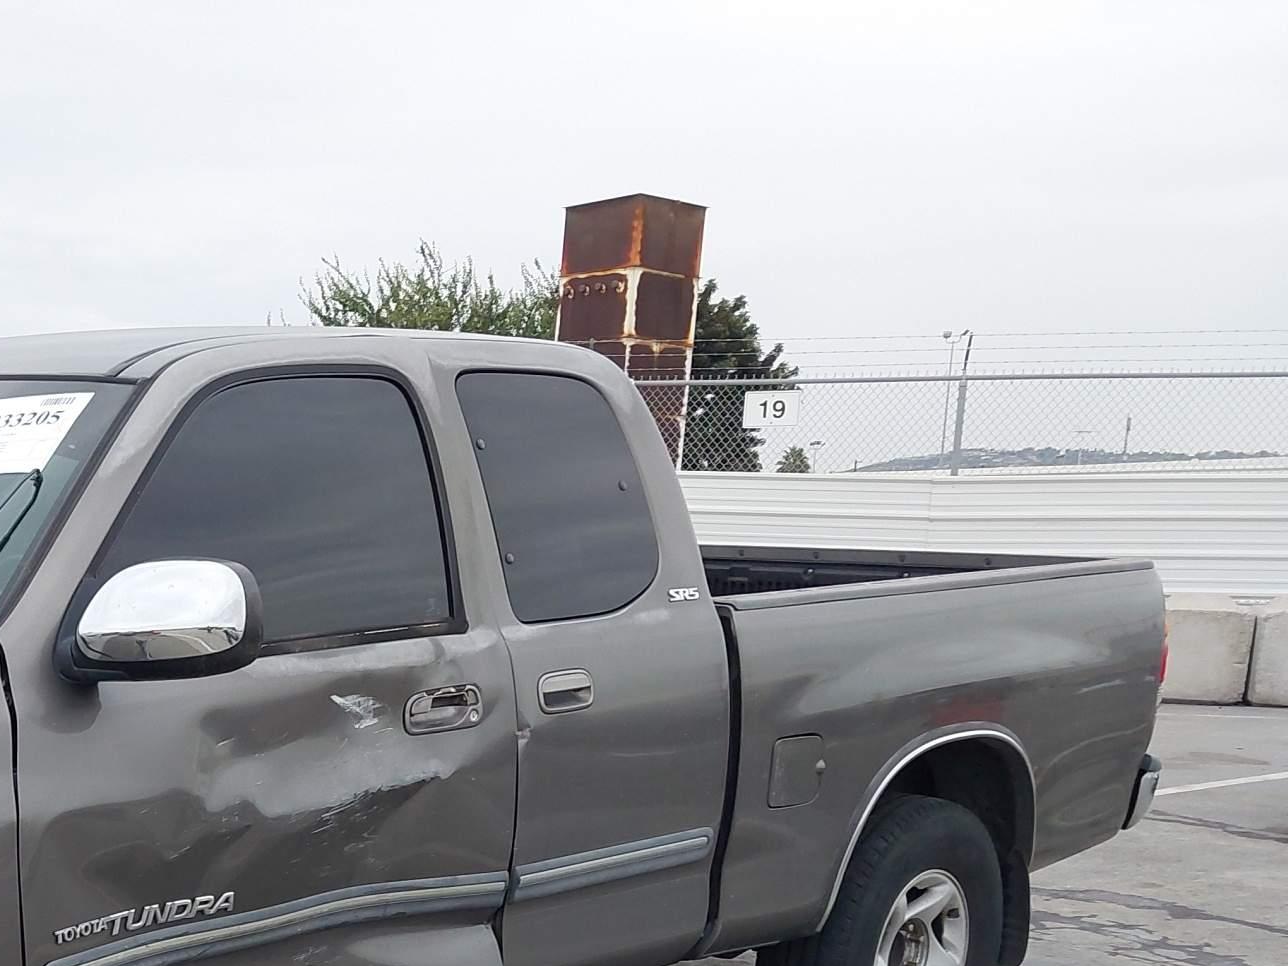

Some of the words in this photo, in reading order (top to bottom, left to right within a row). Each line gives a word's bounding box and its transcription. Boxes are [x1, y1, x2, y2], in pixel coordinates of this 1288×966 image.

[759, 400, 786, 419] 19
[668, 587, 700, 602] SR5
[54, 917, 108, 944] TOYOTA
[109, 891, 235, 936] TUNDRA
